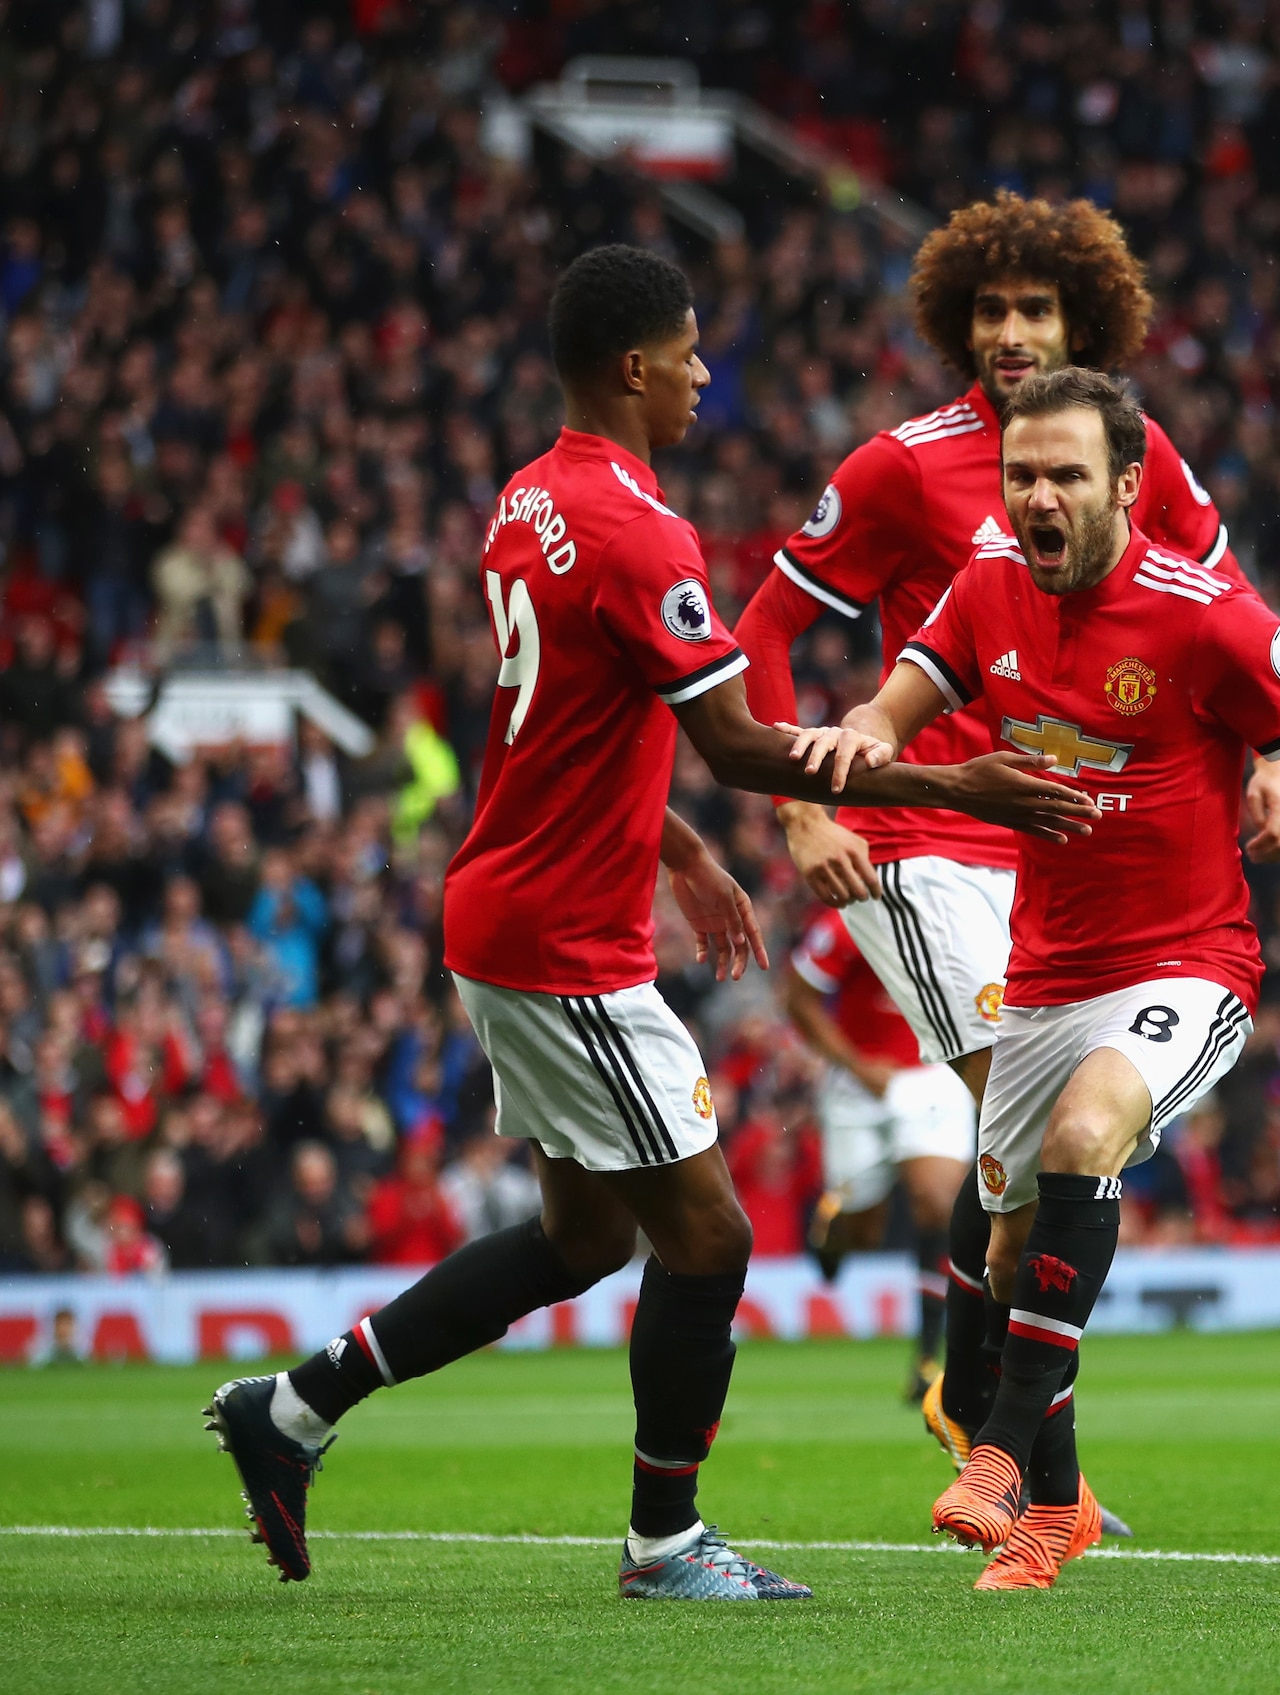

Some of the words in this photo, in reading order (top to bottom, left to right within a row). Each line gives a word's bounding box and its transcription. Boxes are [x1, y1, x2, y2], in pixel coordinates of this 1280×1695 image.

[990, 664, 1021, 681] adidas
[1110, 661, 1152, 682] MANCHESTER
[1114, 700, 1145, 712] UNITED
[1128, 1005, 1180, 1043] 8
